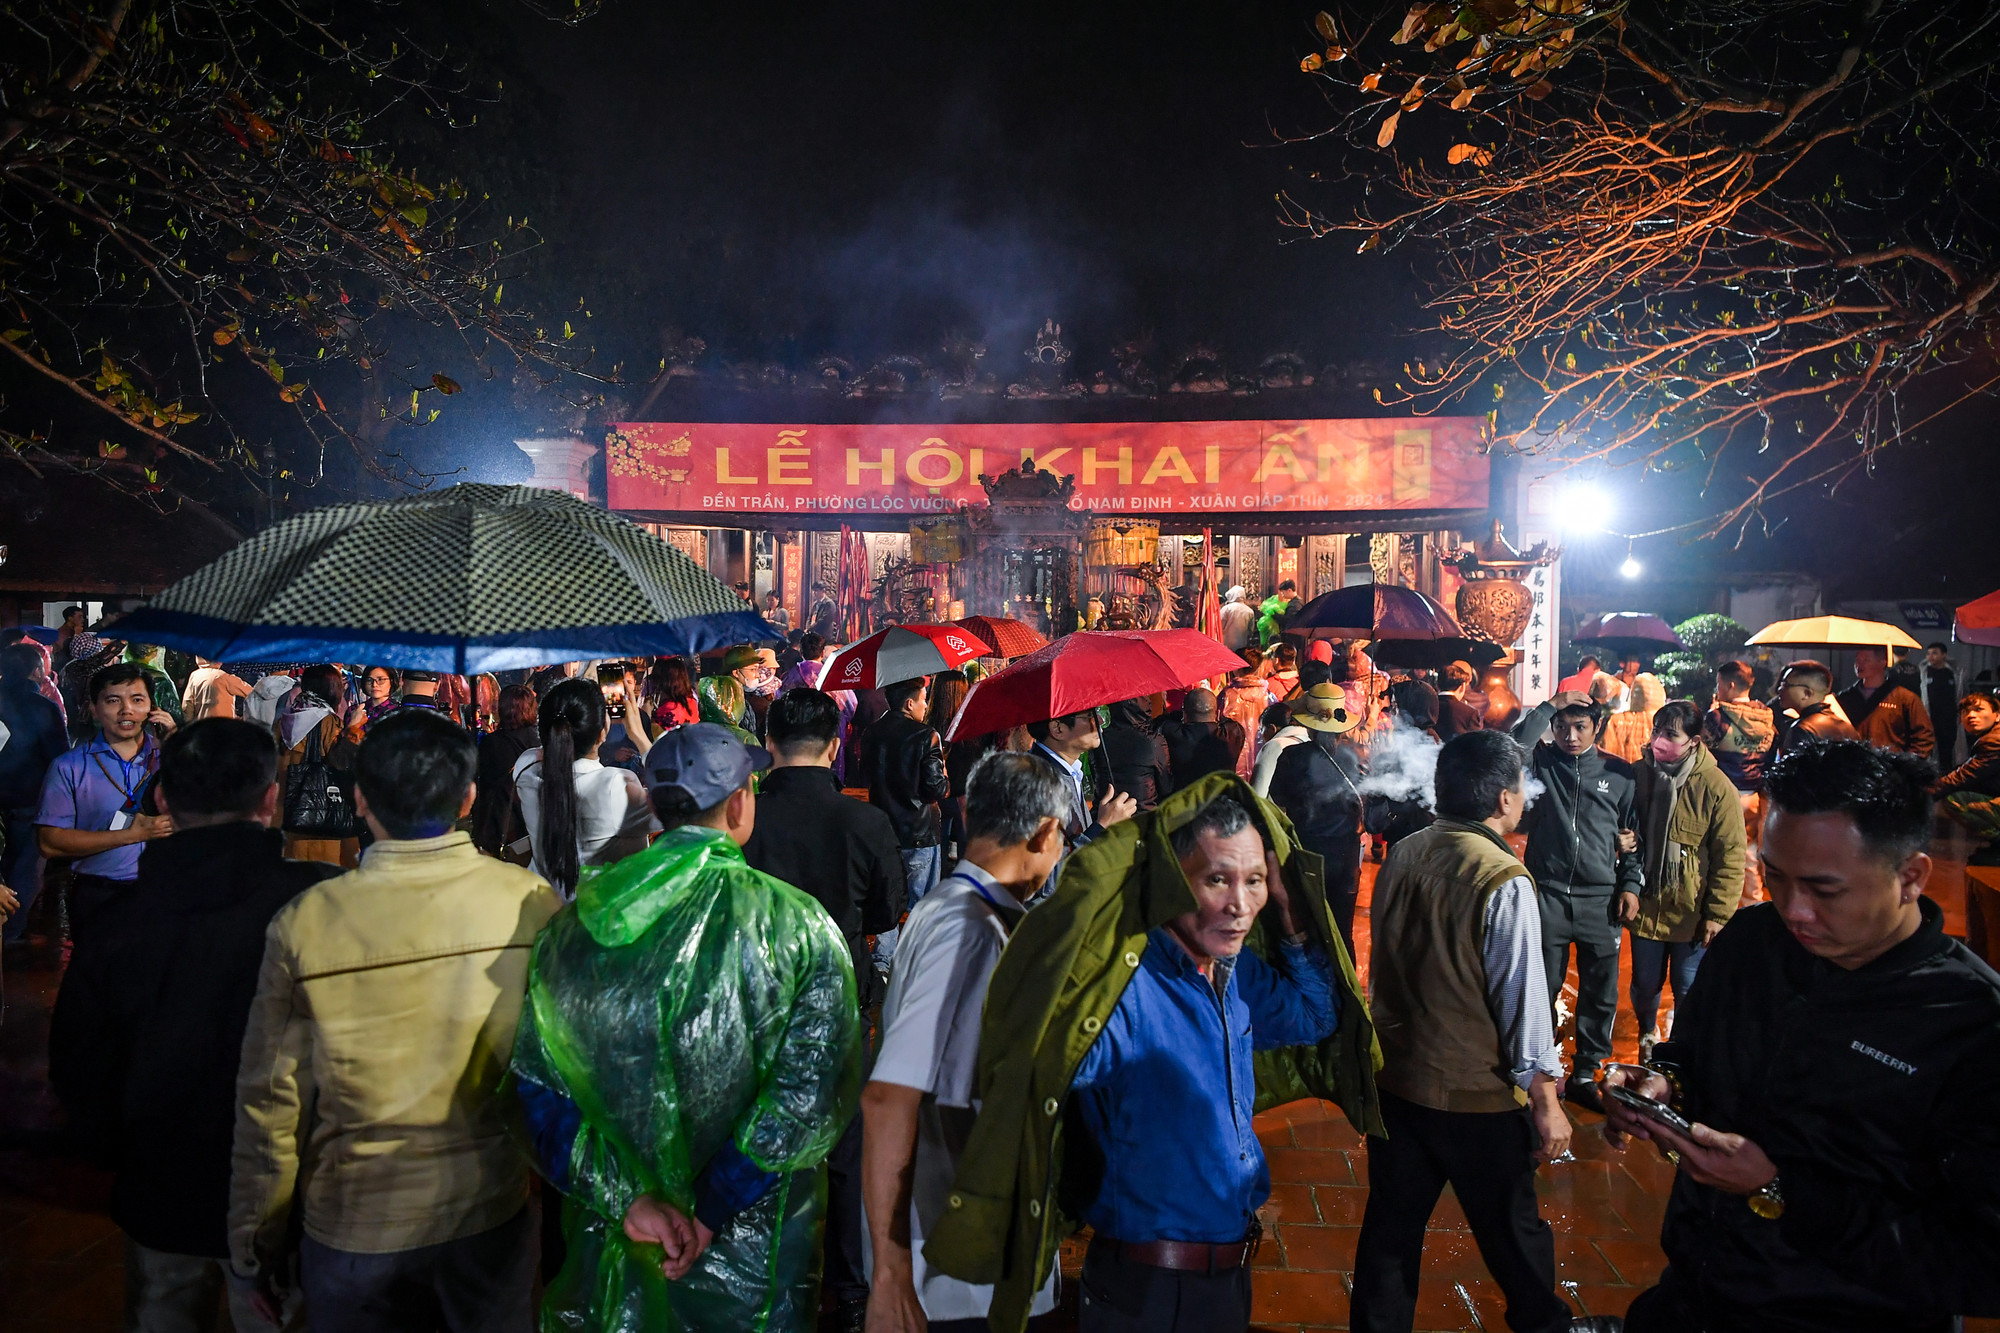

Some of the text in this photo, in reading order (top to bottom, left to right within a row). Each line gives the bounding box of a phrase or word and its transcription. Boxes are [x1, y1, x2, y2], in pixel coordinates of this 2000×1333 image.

[715, 426, 1370, 495] LỄ HỘI KHAI ẤN
[702, 491, 736, 508] ĐỀN
[741, 492, 790, 510] TRẦN,
[795, 493, 867, 510] PHƯỜNG
[871, 494, 904, 512] LỘC
[910, 496, 969, 512] VƯỢNG
[1088, 497, 1125, 509] NAM
[1130, 496, 1172, 512] ĐỊNH
[1189, 494, 1236, 508] XUÂN
[1242, 491, 1283, 508] GIÁP
[1288, 491, 1329, 507] THÌN
[1345, 494, 1384, 507] 2024
[1851, 1040, 1918, 1075] BURBERRY
